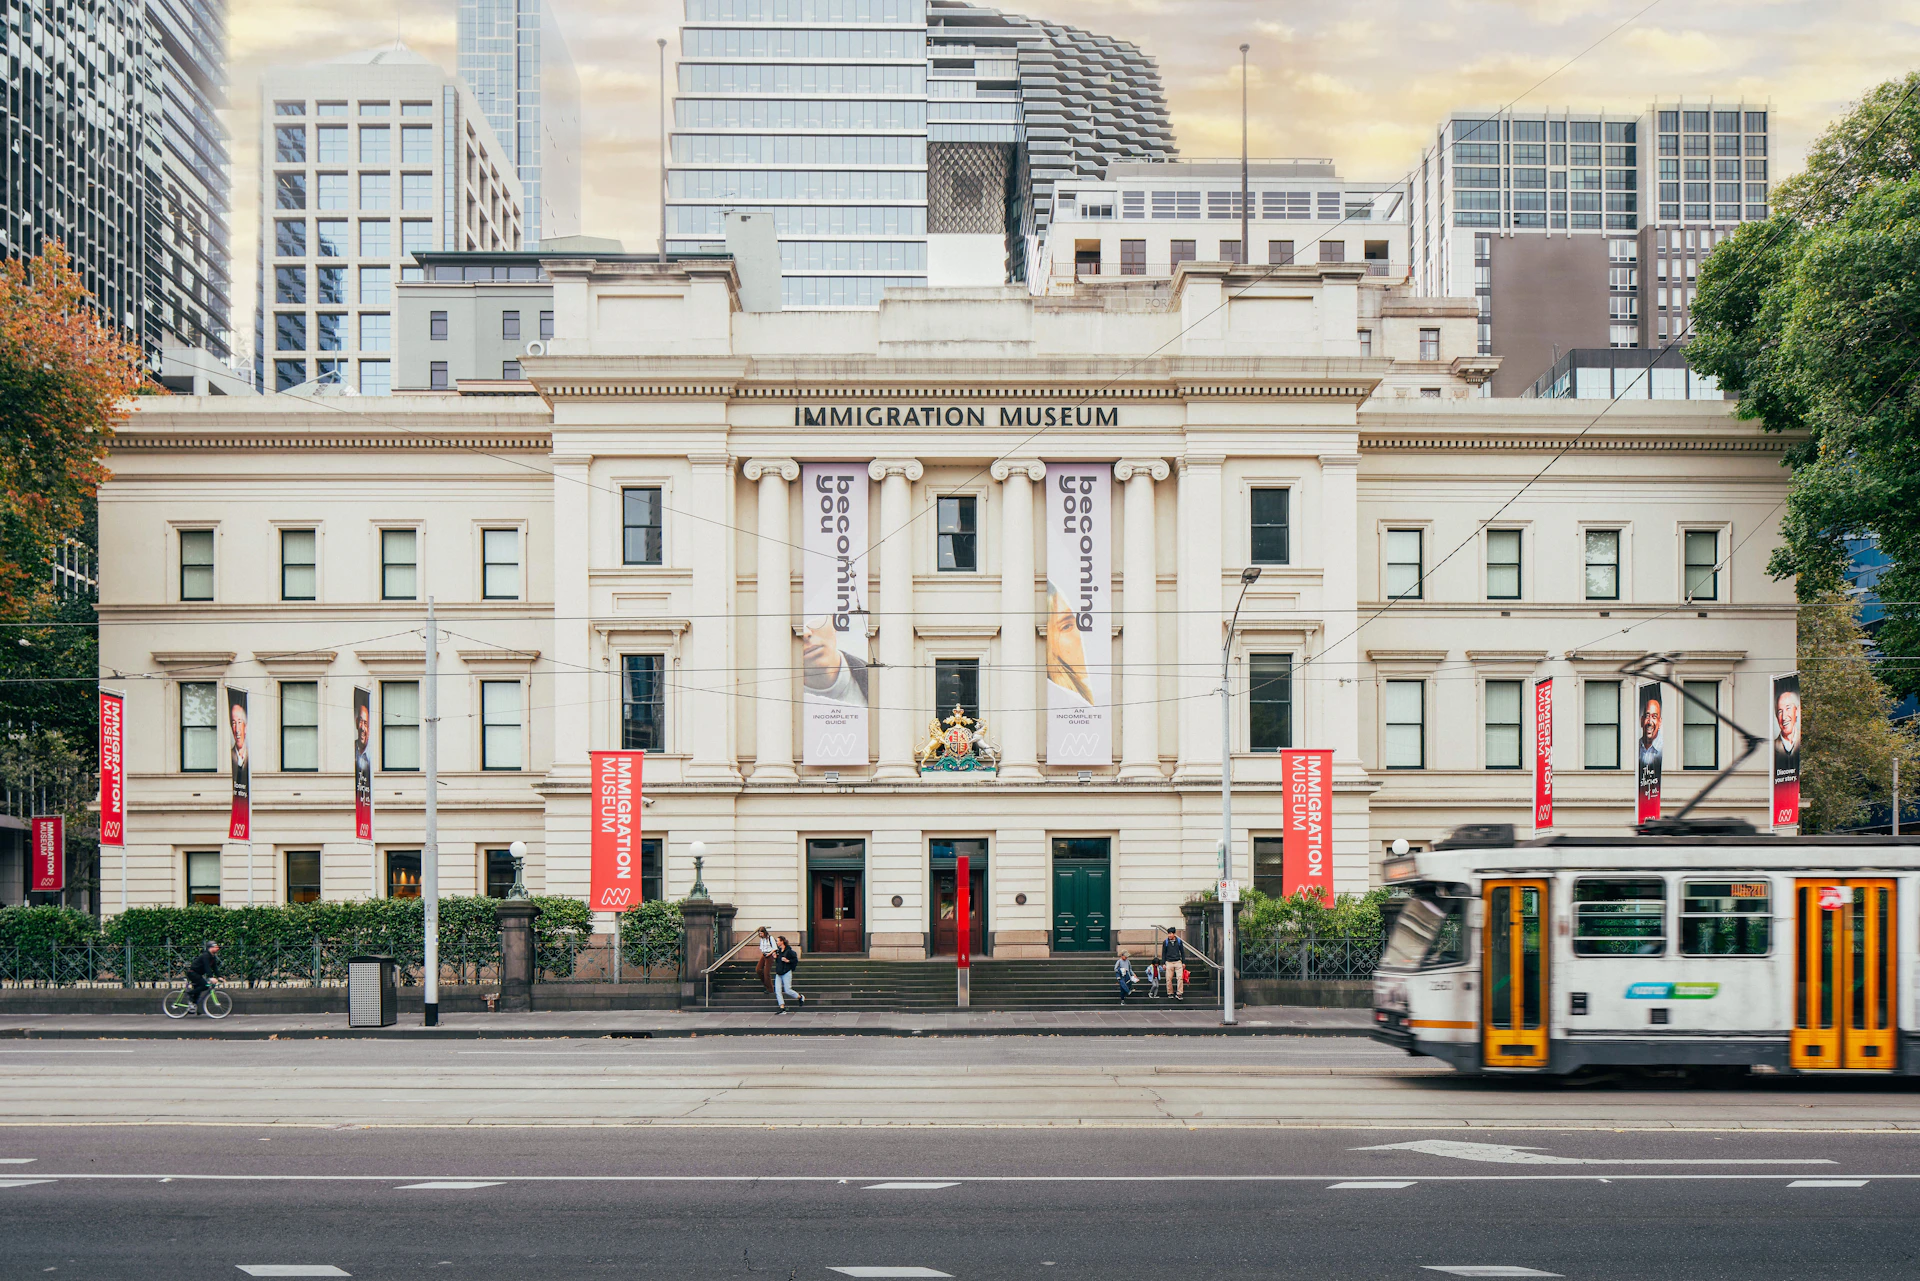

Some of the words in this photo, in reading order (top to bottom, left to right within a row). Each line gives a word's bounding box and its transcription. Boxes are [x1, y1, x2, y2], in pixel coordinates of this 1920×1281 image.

[1145, 298, 1170, 307] POR
[794, 406, 985, 426] IMMIGRATION
[1000, 406, 1118, 426] MUSEUM
[816, 474, 834, 533] you
[1059, 474, 1076, 533] you
[832, 475, 856, 632] becoming
[1076, 475, 1099, 632] becoming
[103, 699, 112, 770] MUSEUM
[112, 702, 120, 813] IMMIGRATION
[601, 757, 616, 833] MUSEUM
[1292, 755, 1307, 830] MUSEUM
[1776, 768, 1796, 776] Discover
[40, 821, 48, 856] MUSEUM
[47, 821, 55, 876] IMMIGRATION
[617, 757, 632, 879] IMMIGRATION
[1308, 755, 1323, 876] IMMIGRATION
